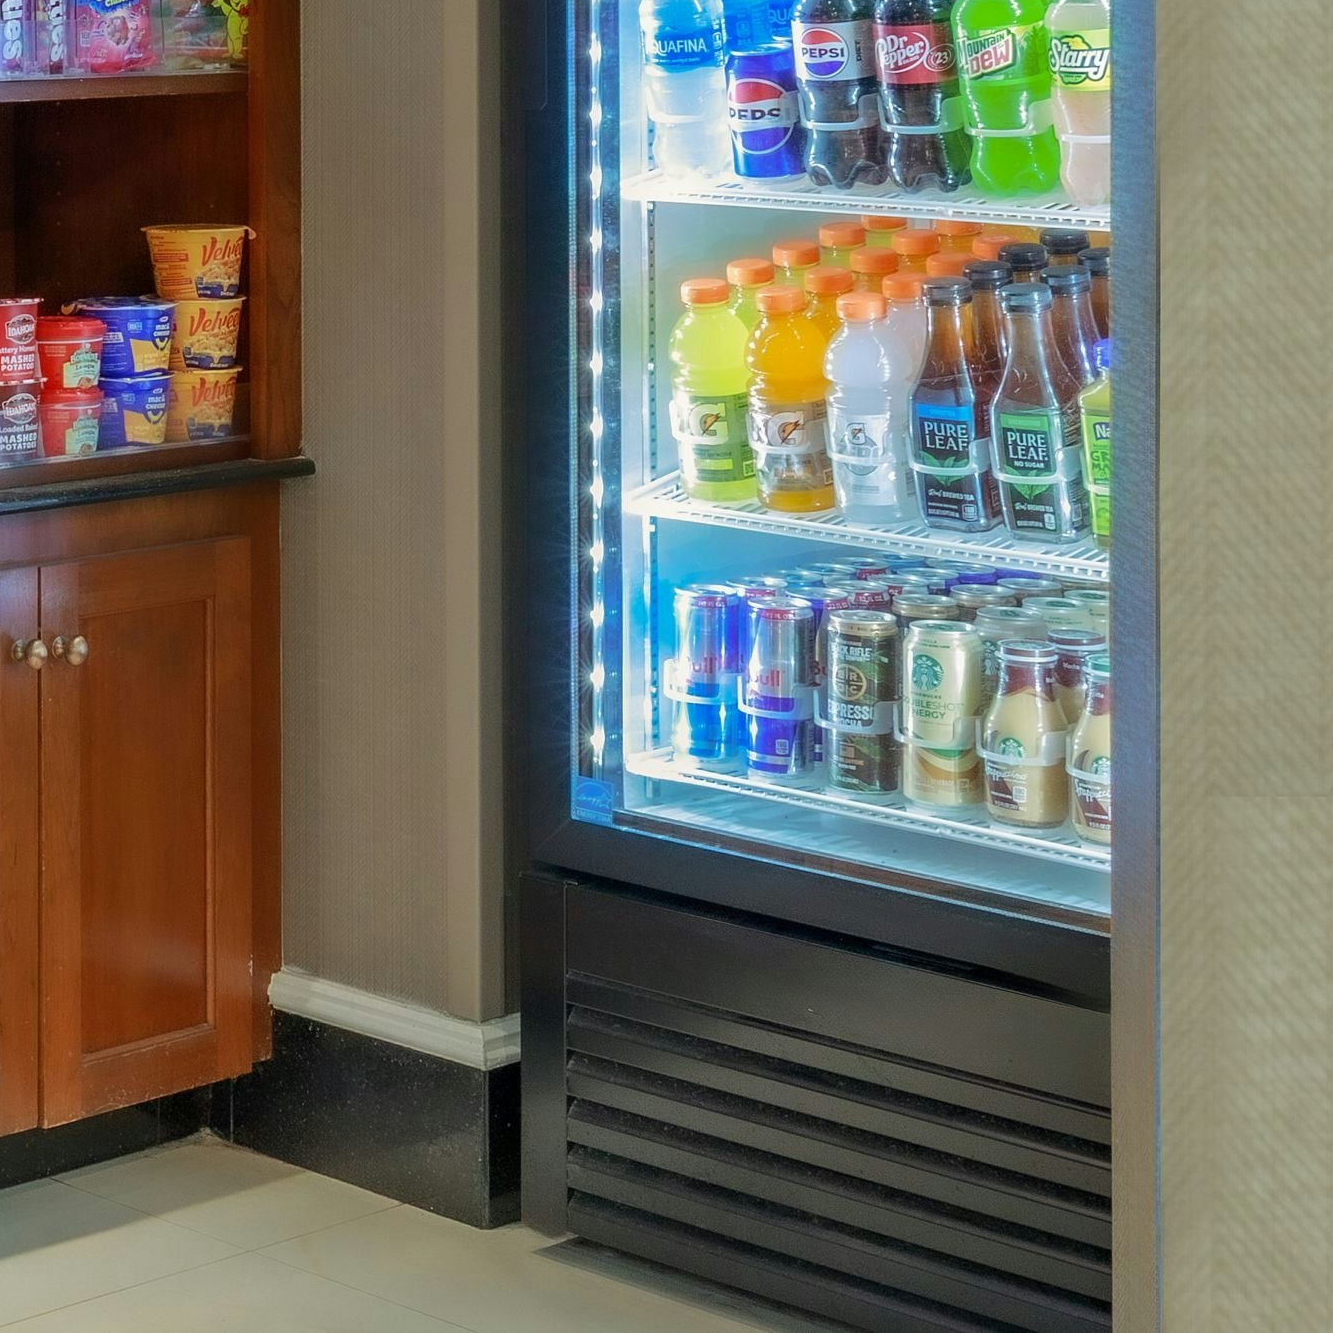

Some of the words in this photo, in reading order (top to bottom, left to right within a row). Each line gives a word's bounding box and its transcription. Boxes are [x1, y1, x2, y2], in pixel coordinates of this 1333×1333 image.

[802, 47, 846, 59] PEPSI
[933, 50, 949, 64] 23
[1049, 39, 1110, 79] Starry
[923, 421, 968, 438] PURE
[925, 434, 967, 451] LEAF
[1006, 431, 1047, 448] PURE
[1007, 445, 1047, 461] LEAF
[1013, 460, 1024, 468] NO
[1024, 460, 1045, 469] SUGAR
